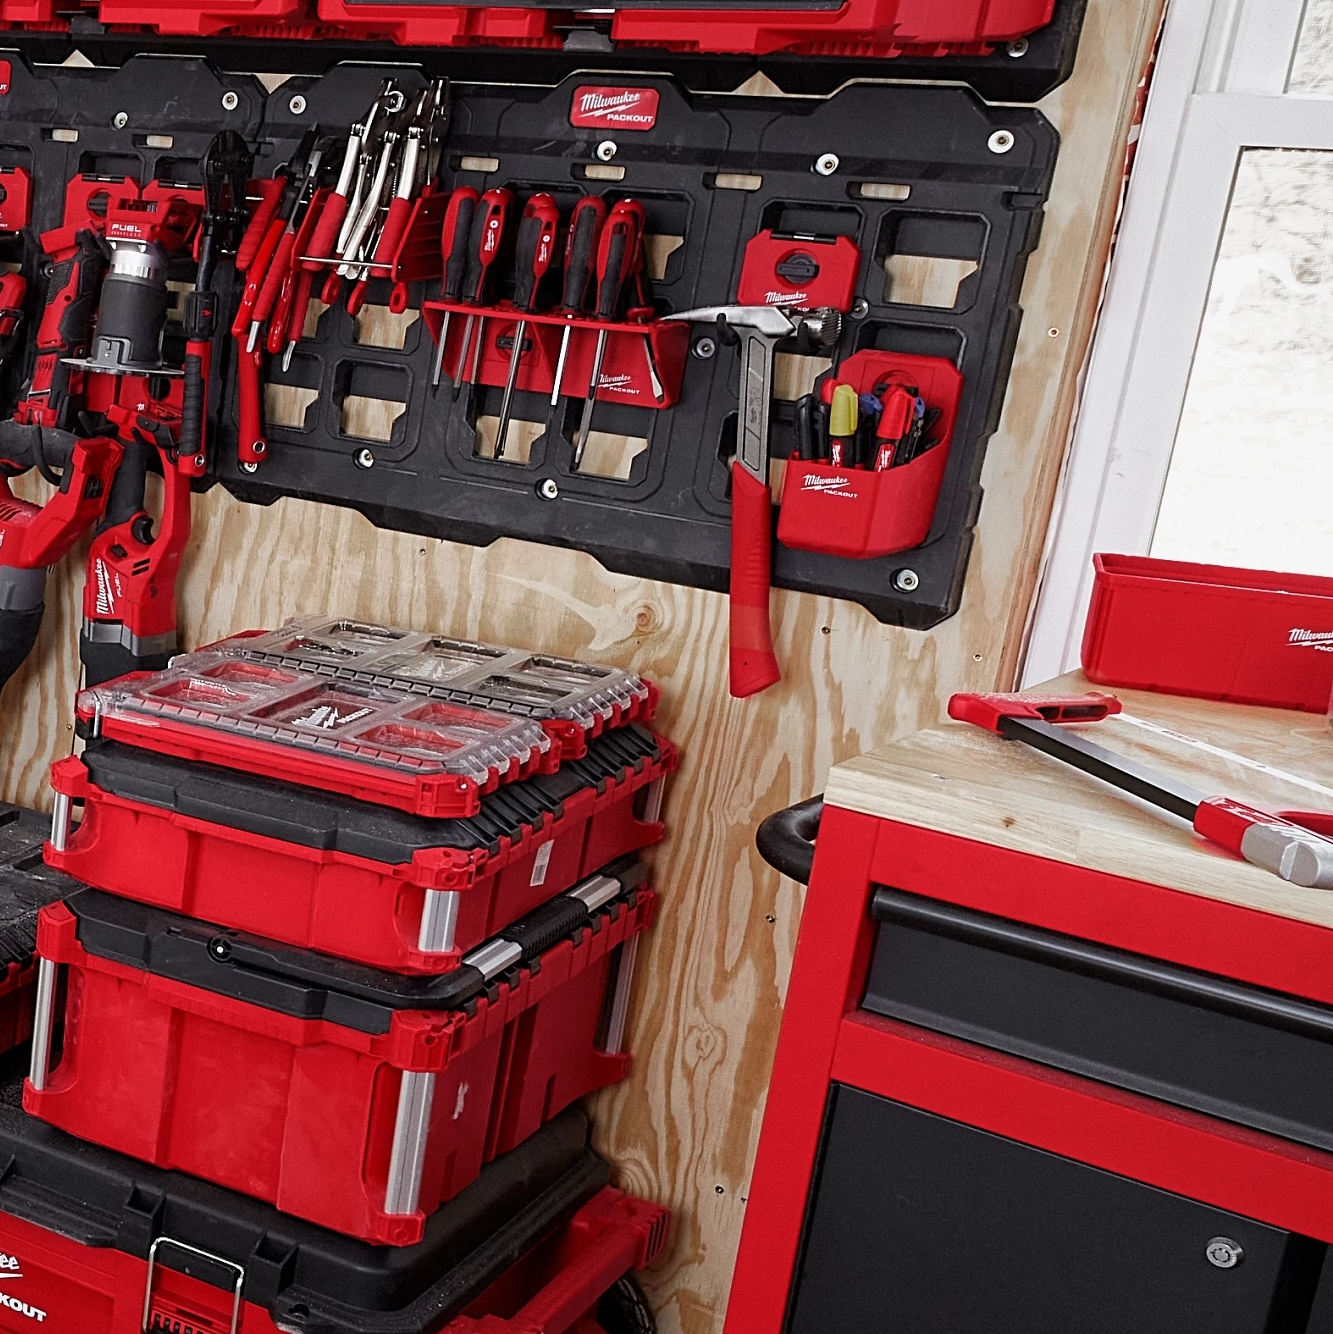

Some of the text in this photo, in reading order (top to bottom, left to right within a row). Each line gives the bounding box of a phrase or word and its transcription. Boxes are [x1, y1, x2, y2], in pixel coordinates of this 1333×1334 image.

[579, 91, 640, 111] Milwaukee
[606, 114, 653, 122] PACKOUT
[112, 224, 142, 233] FUEL
[764, 291, 807, 303] Milwaukee
[803, 474, 848, 486] Milwaukee
[95, 557, 109, 614] Milwaukee
[1288, 628, 1333, 642] Milwau
